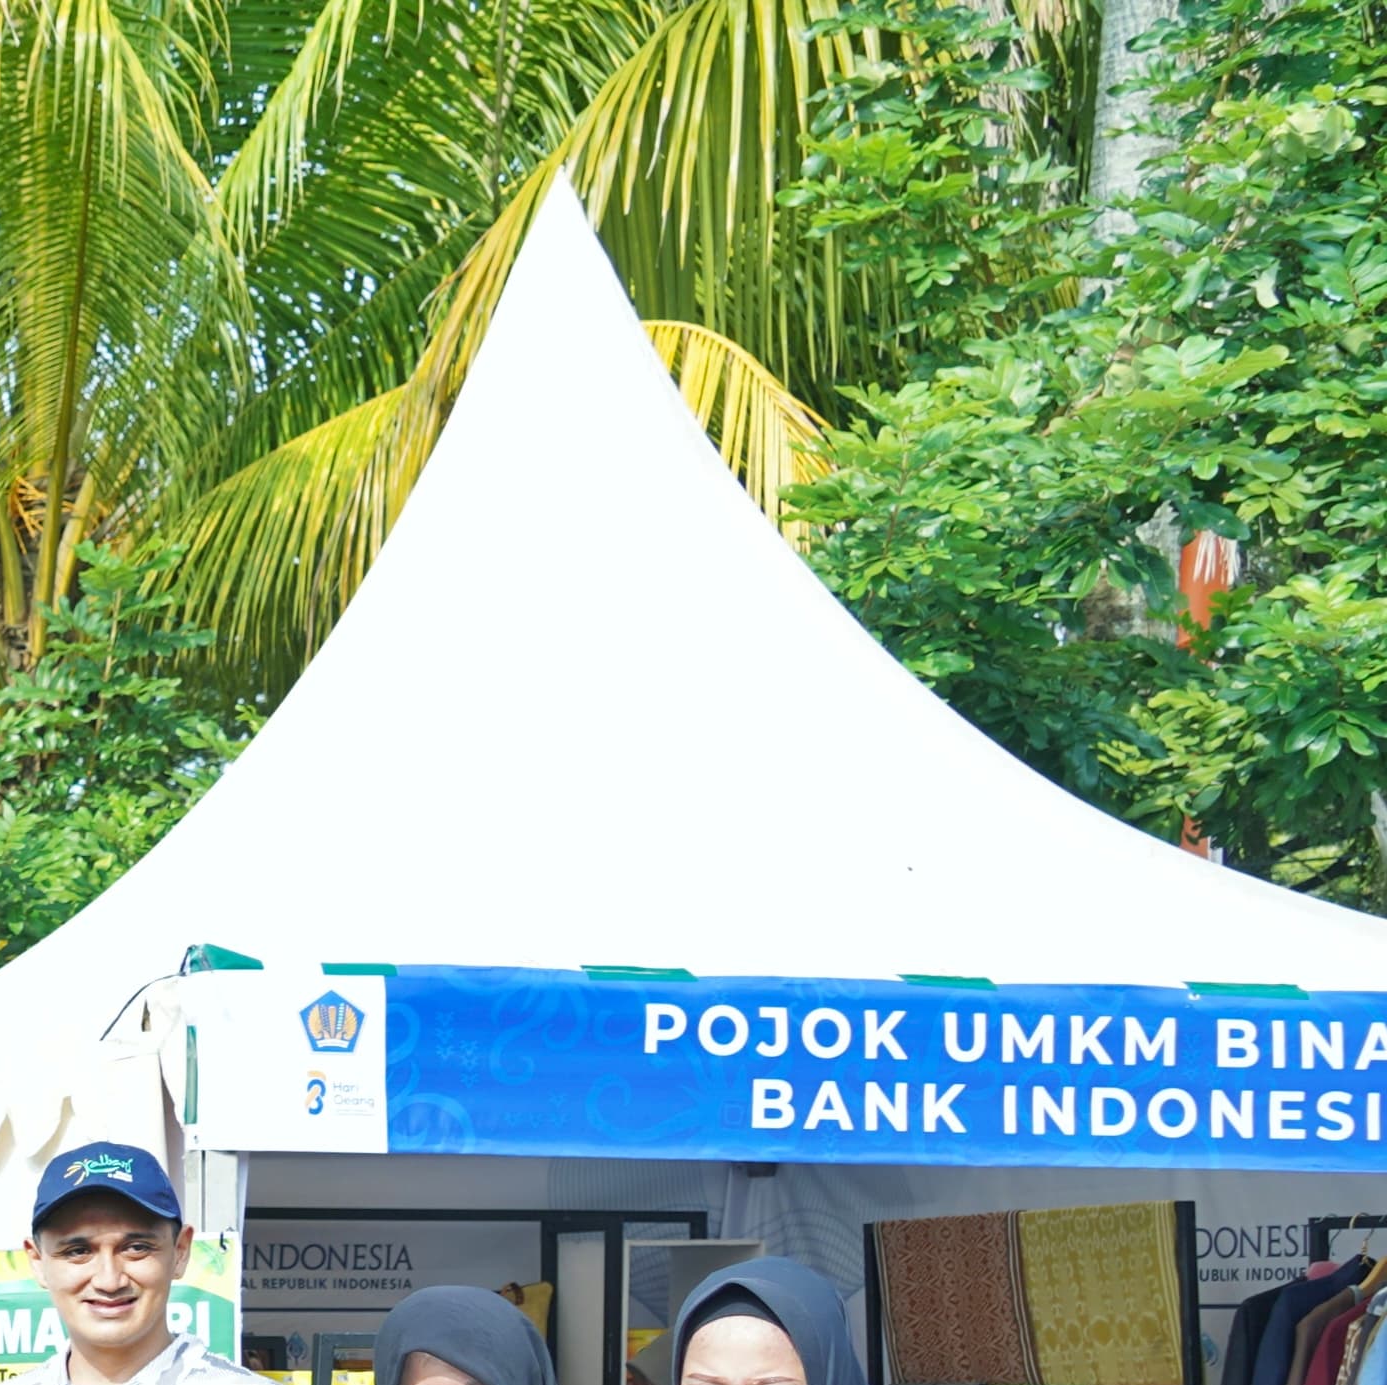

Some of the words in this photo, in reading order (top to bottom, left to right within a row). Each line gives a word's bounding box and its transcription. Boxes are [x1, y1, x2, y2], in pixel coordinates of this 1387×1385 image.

[643, 1002, 908, 1060] POJOK
[943, 1012, 1177, 1067] UMKM
[750, 1078, 968, 1134] BANK
[1003, 1084, 1382, 1142] INDONESI
[243, 1243, 413, 1271] INDONESIA
[261, 1278, 327, 1289] REPUBLIK
[333, 1278, 412, 1289] INDONESIA
[1199, 1268, 1239, 1282] UBLIK
